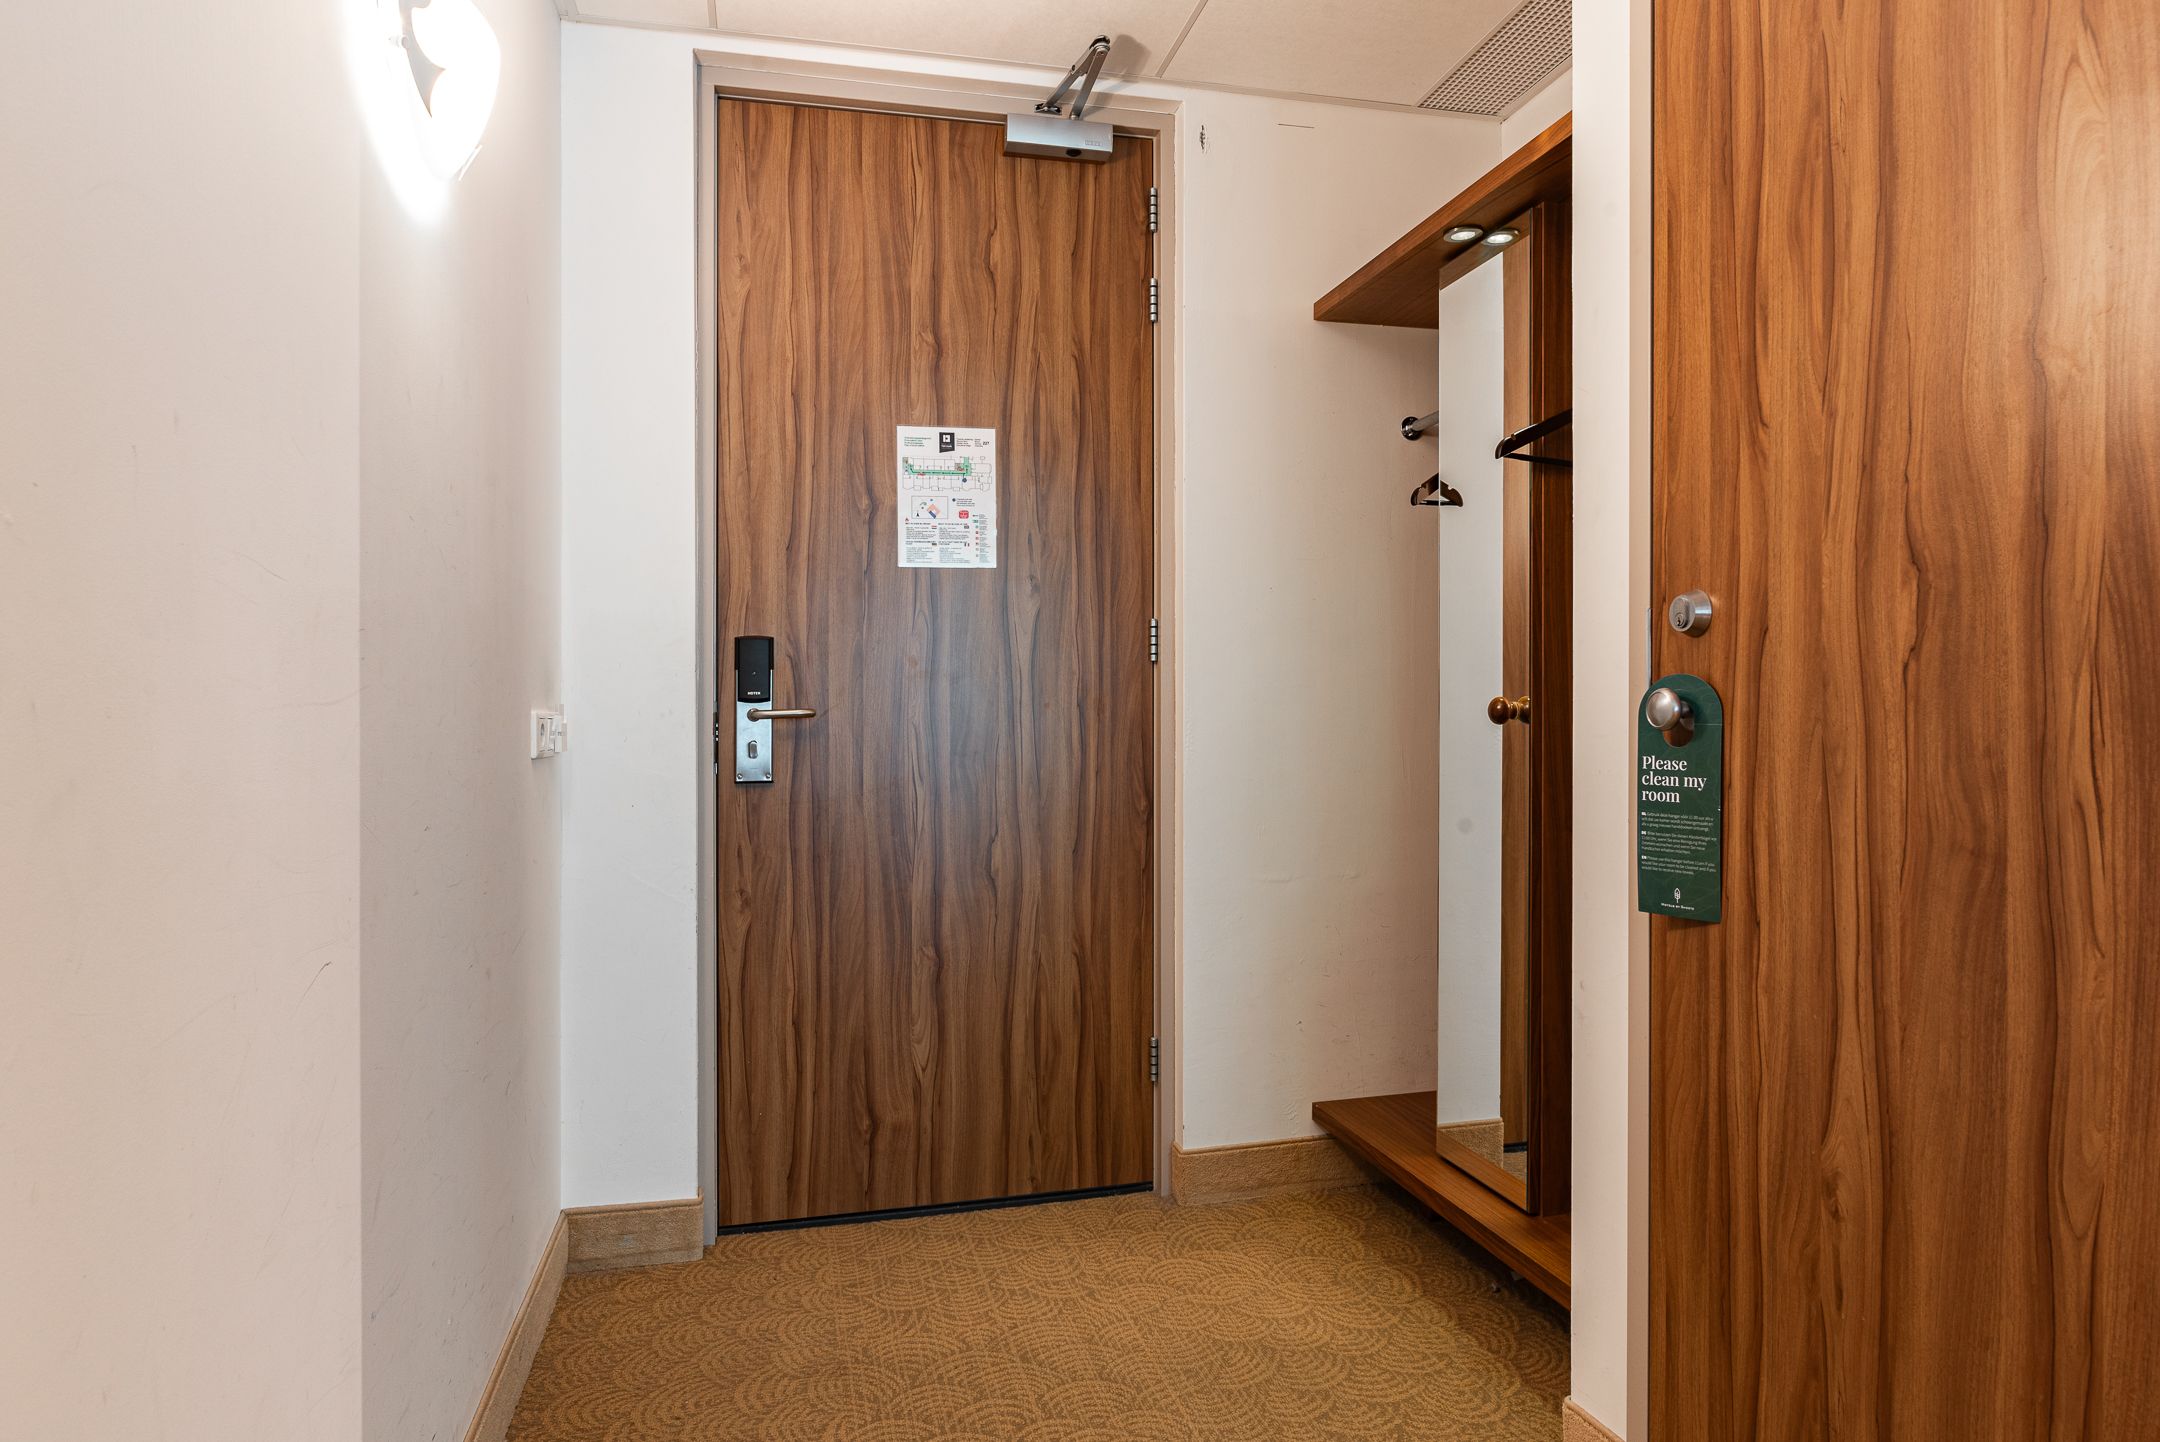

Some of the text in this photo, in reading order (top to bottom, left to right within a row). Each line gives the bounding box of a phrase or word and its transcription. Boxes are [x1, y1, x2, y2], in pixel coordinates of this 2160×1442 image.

[1642, 755, 1687, 770] Please
[1642, 770, 1706, 790] clean my
[1642, 790, 1680, 802] room
